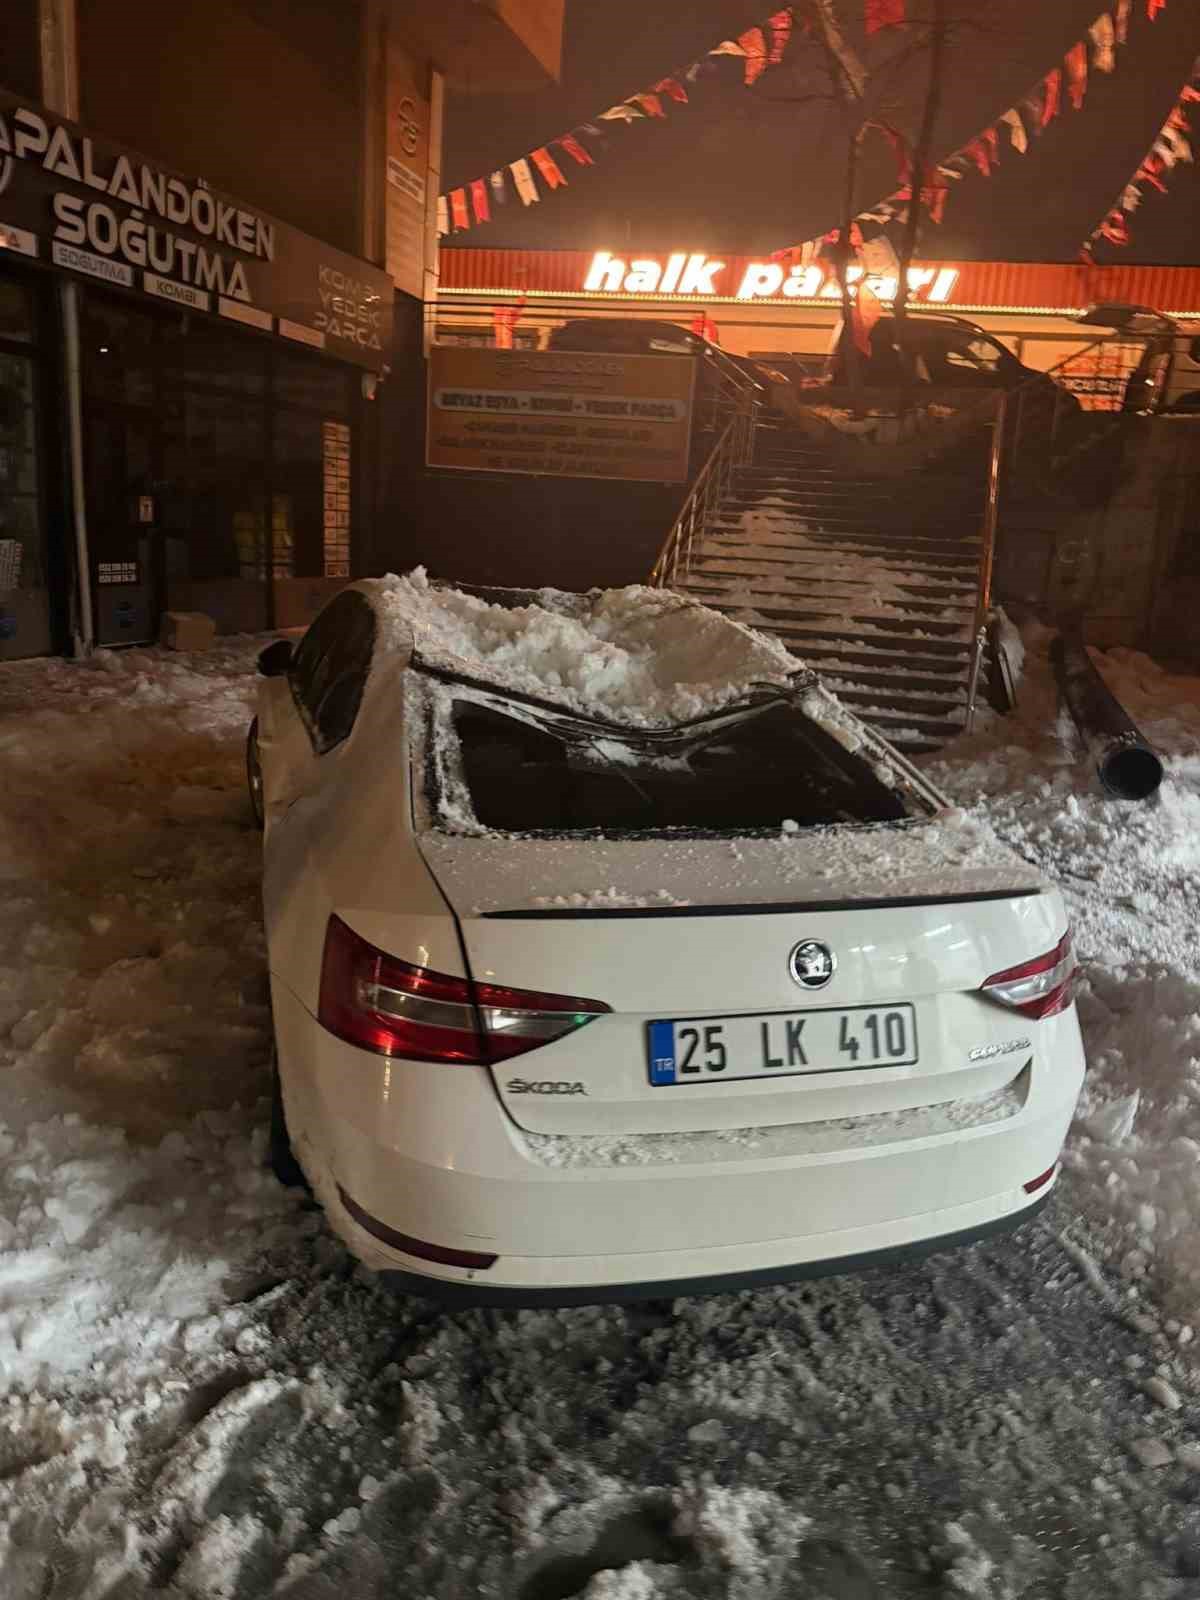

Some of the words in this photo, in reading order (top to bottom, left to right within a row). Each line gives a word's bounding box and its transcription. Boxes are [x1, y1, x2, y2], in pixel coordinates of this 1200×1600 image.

[53, 192, 251, 301] SOĞUTMA
[584, 251, 725, 295] halk
[317, 287, 382, 329] YEDEK
[313, 311, 384, 352] PARÇA
[679, 1025, 728, 1074] 25
[761, 1019, 809, 1068] LK
[839, 1012, 906, 1061] 410
[655, 1058, 675, 1072] TR
